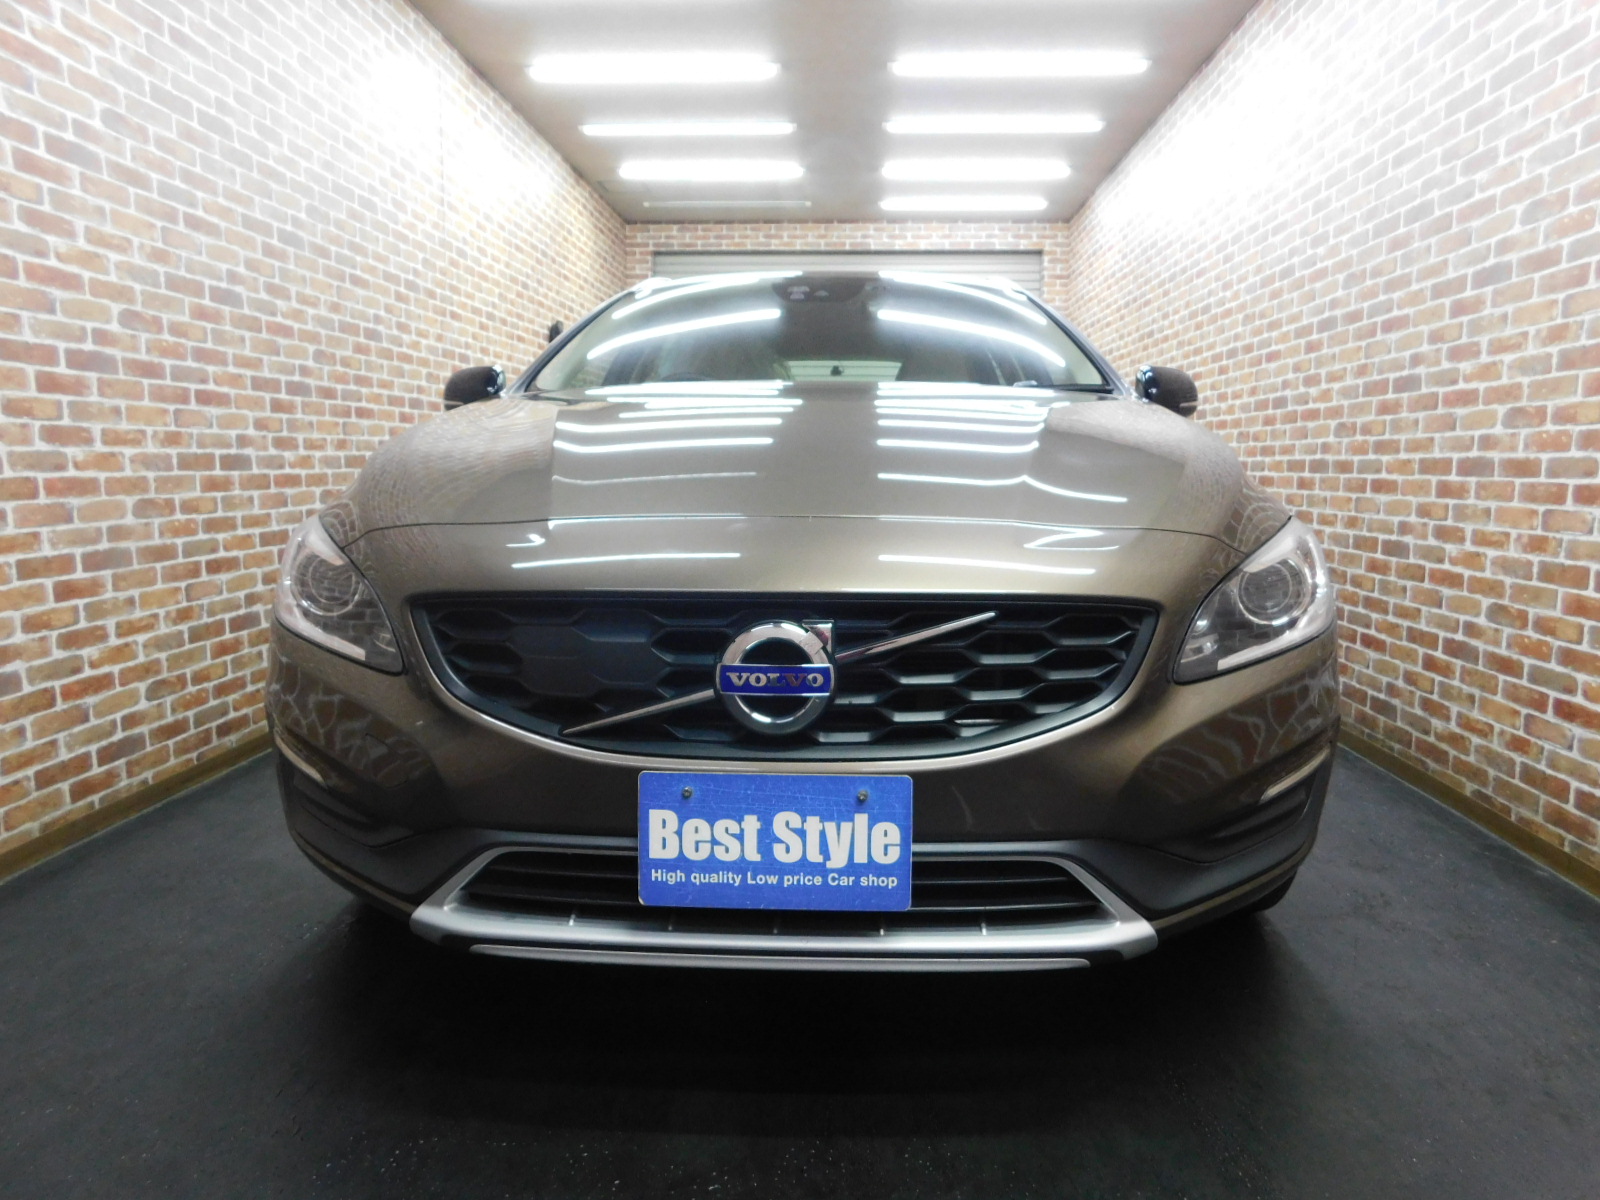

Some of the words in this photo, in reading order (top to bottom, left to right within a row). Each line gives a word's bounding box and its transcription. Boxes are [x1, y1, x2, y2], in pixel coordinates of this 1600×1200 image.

[725, 671, 824, 688] VOLVO
[648, 808, 762, 862] Best
[772, 811, 901, 869] Style
[651, 868, 686, 885] High
[690, 870, 742, 887] quality
[747, 871, 778, 885] Low
[783, 872, 823, 888] price
[827, 873, 855, 886] Car
[860, 873, 898, 889] shop
